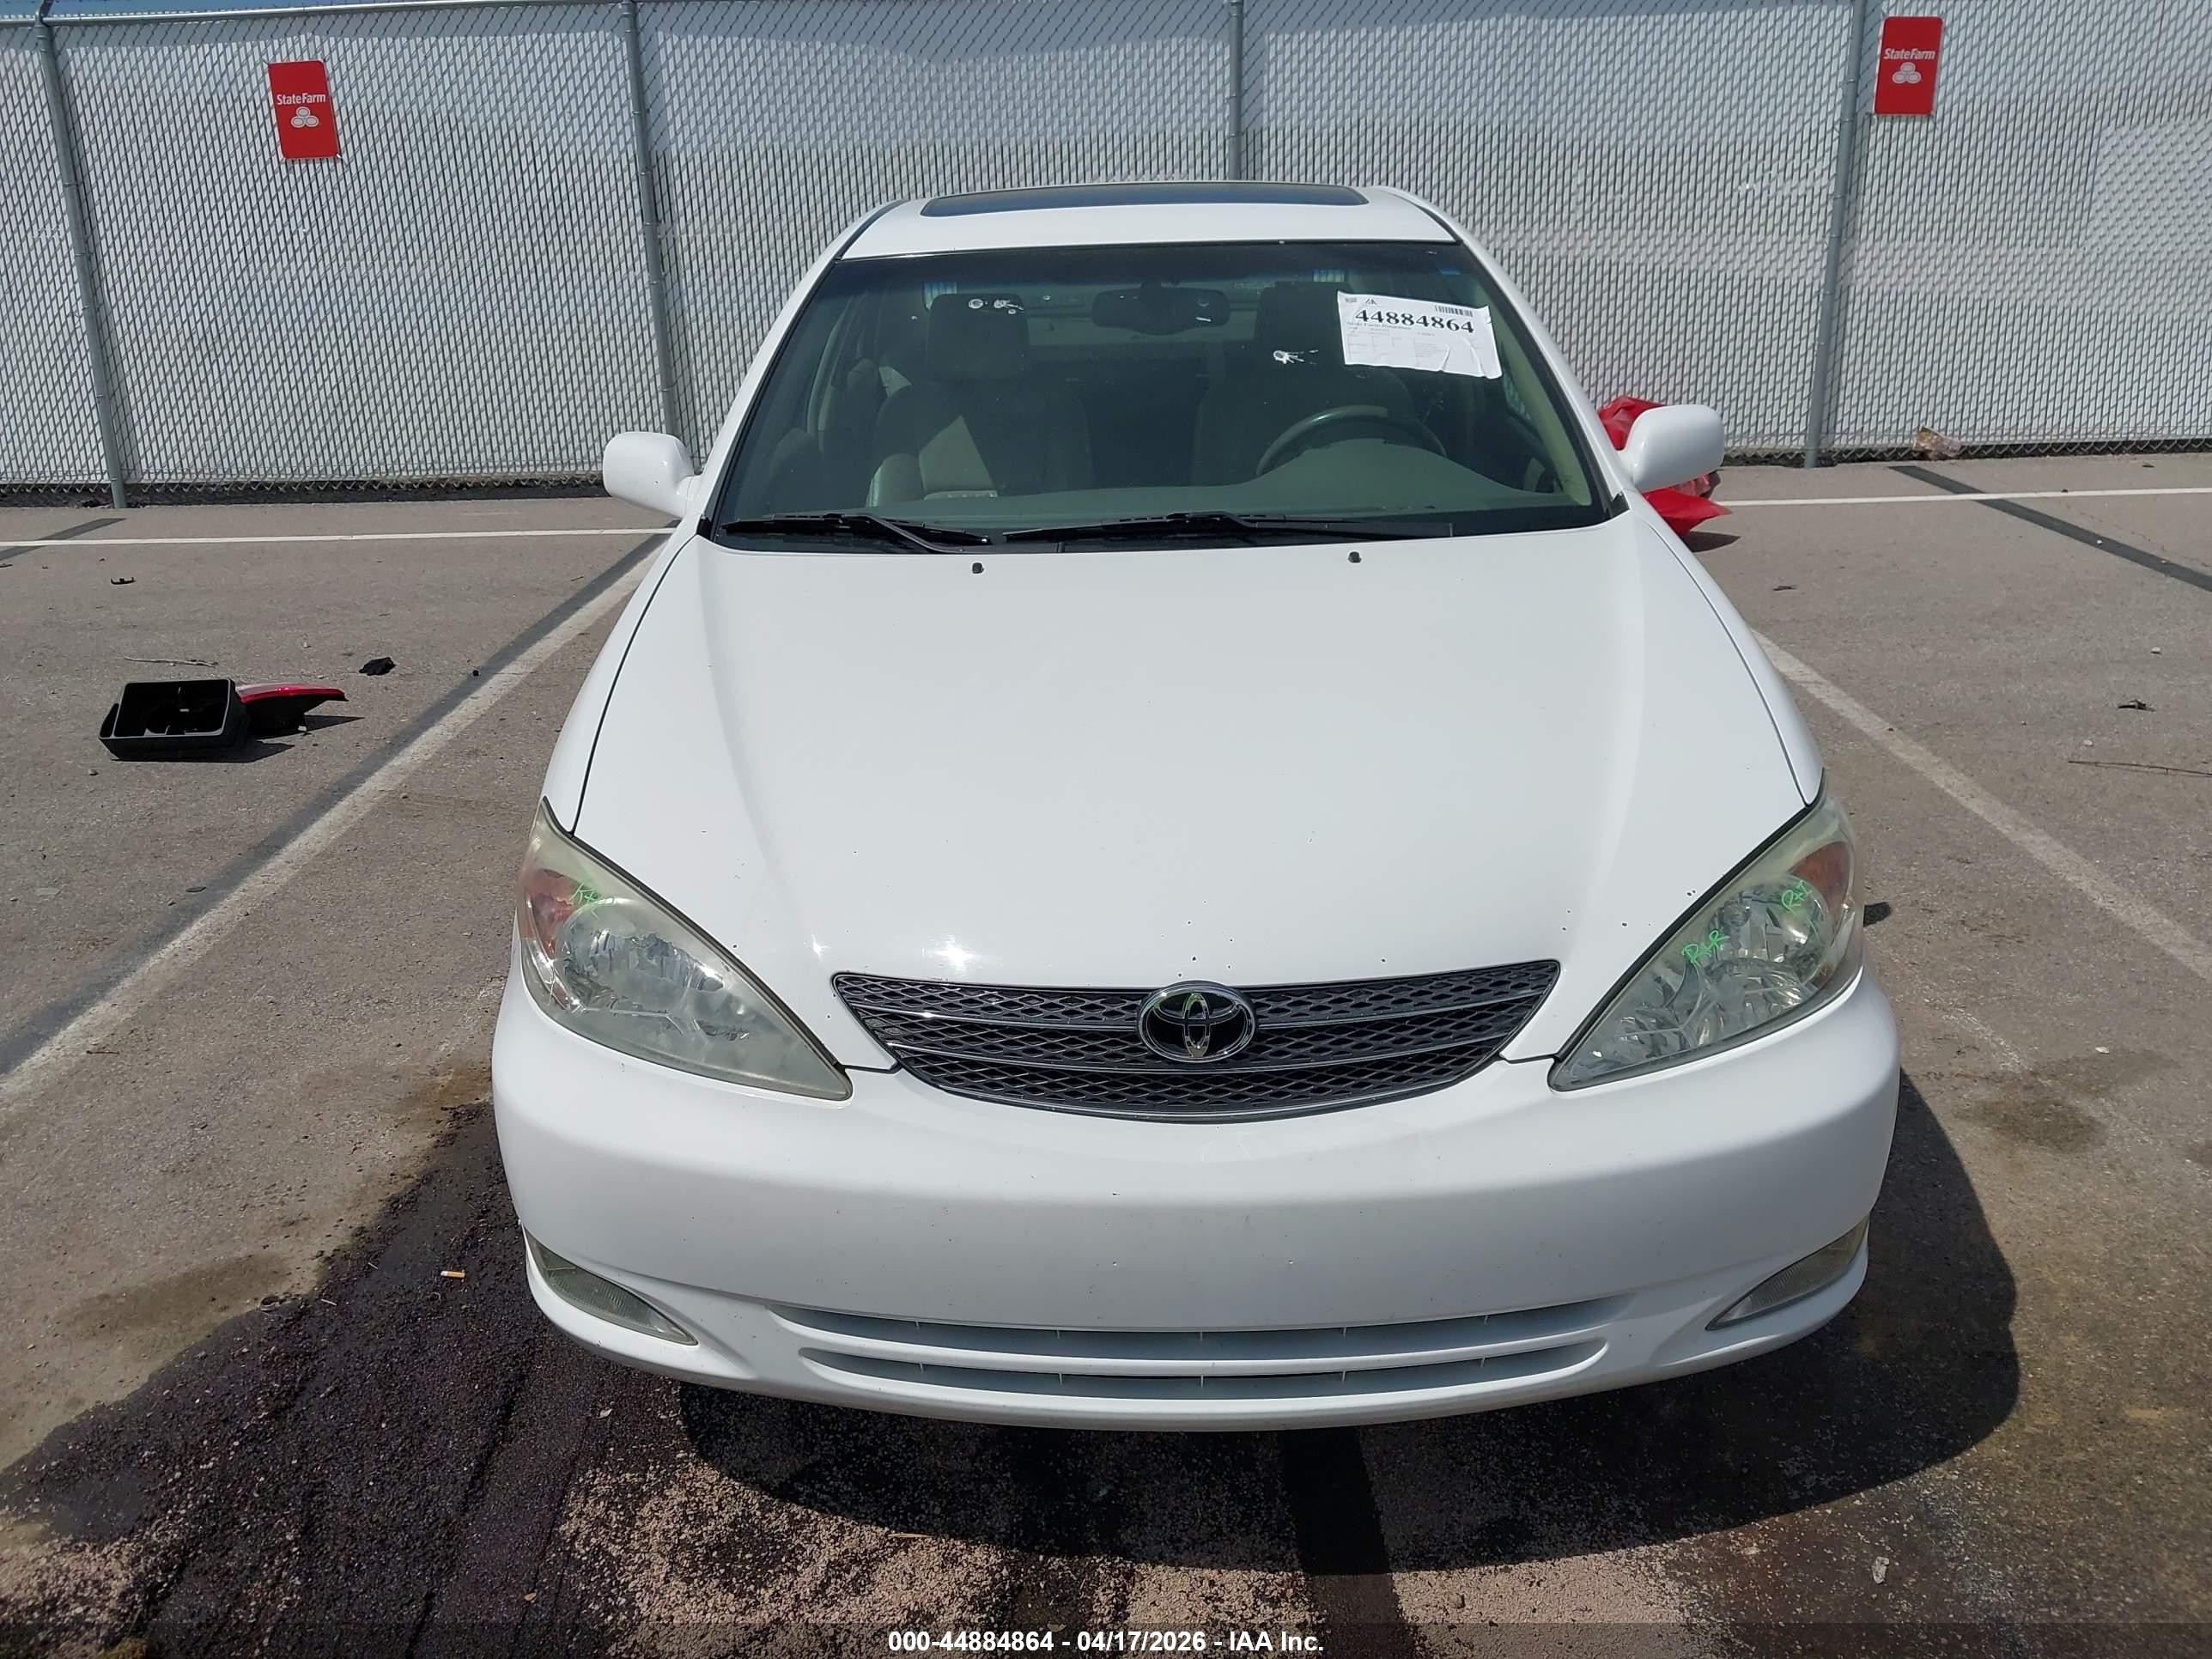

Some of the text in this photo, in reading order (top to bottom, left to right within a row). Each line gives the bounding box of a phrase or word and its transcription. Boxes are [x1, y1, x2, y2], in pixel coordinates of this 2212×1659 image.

[1883, 48, 1936, 60] StateFarm
[276, 93, 326, 105] StateFarm
[1355, 309, 1474, 333] 44884864
